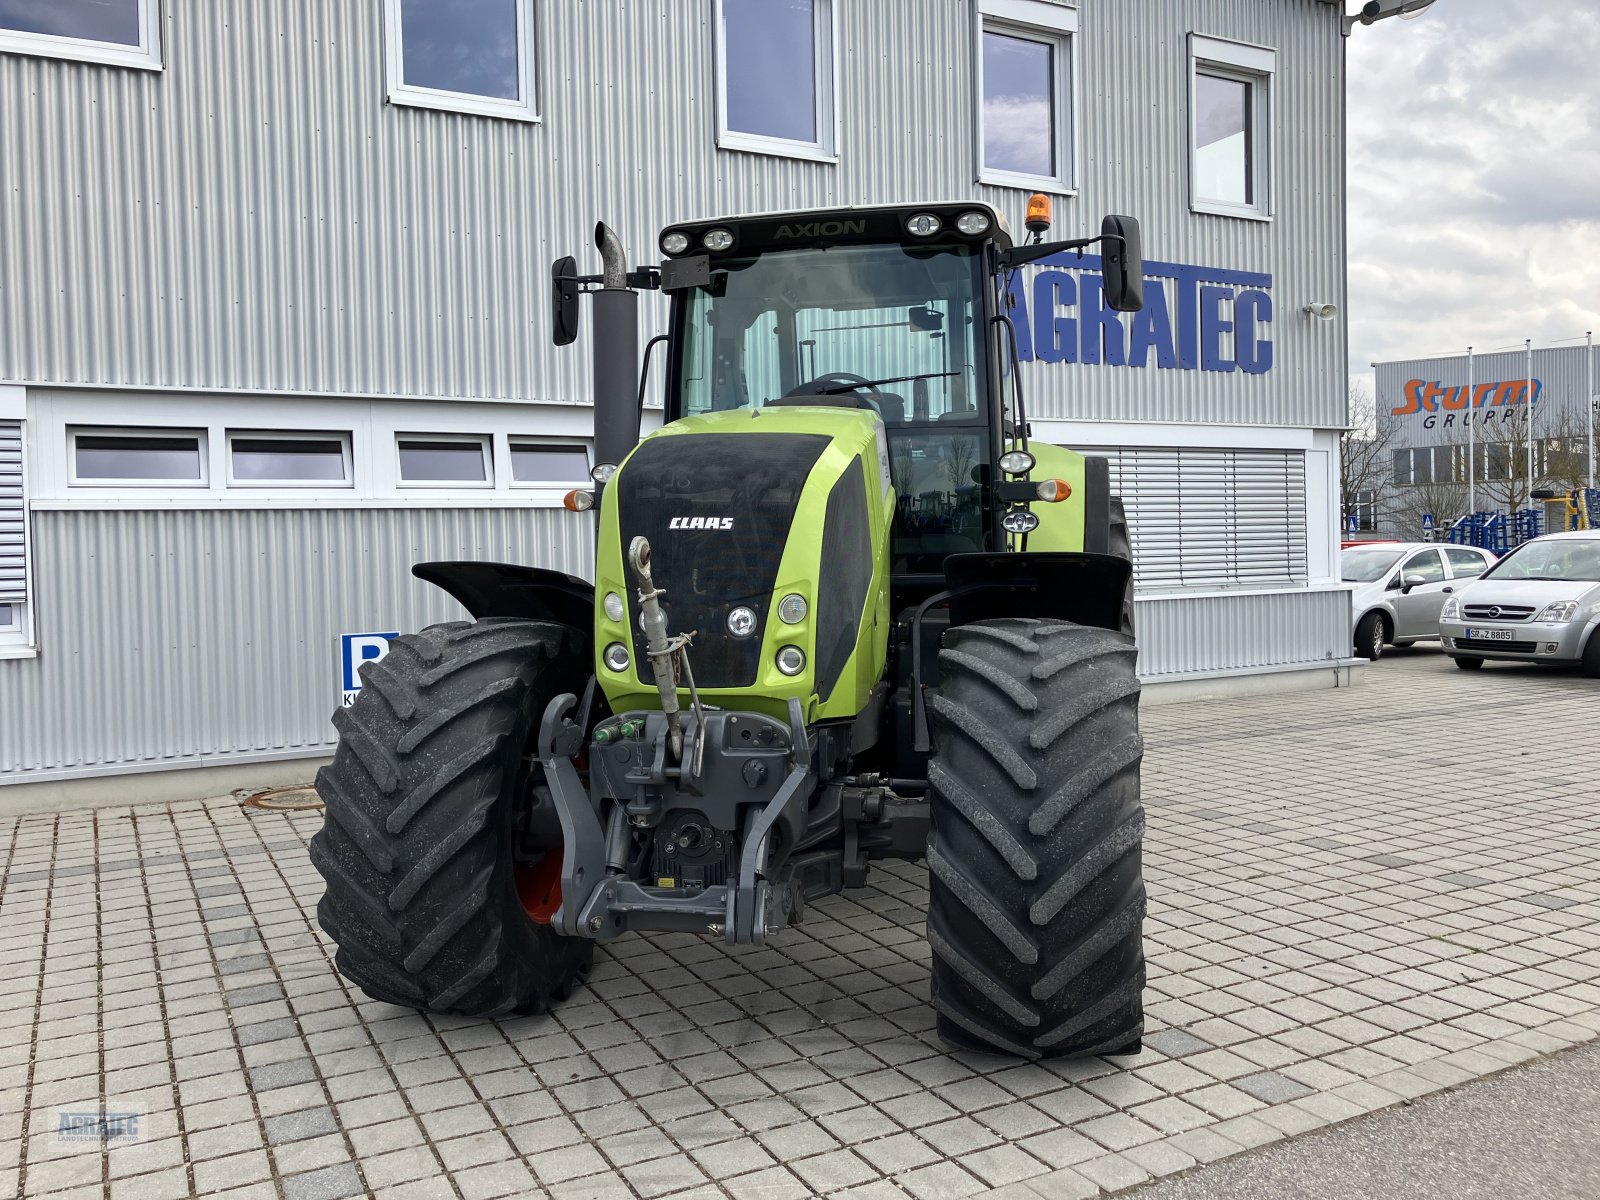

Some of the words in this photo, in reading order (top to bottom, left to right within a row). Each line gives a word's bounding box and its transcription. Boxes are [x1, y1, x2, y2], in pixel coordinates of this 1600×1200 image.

[773, 219, 866, 240] AXION
[999, 251, 1273, 375] AGRATEC
[1391, 378, 1543, 416] Sturm
[669, 517, 734, 530] CLAAS
[1470, 630, 1480, 638] SR
[1484, 630, 1490, 639] Z
